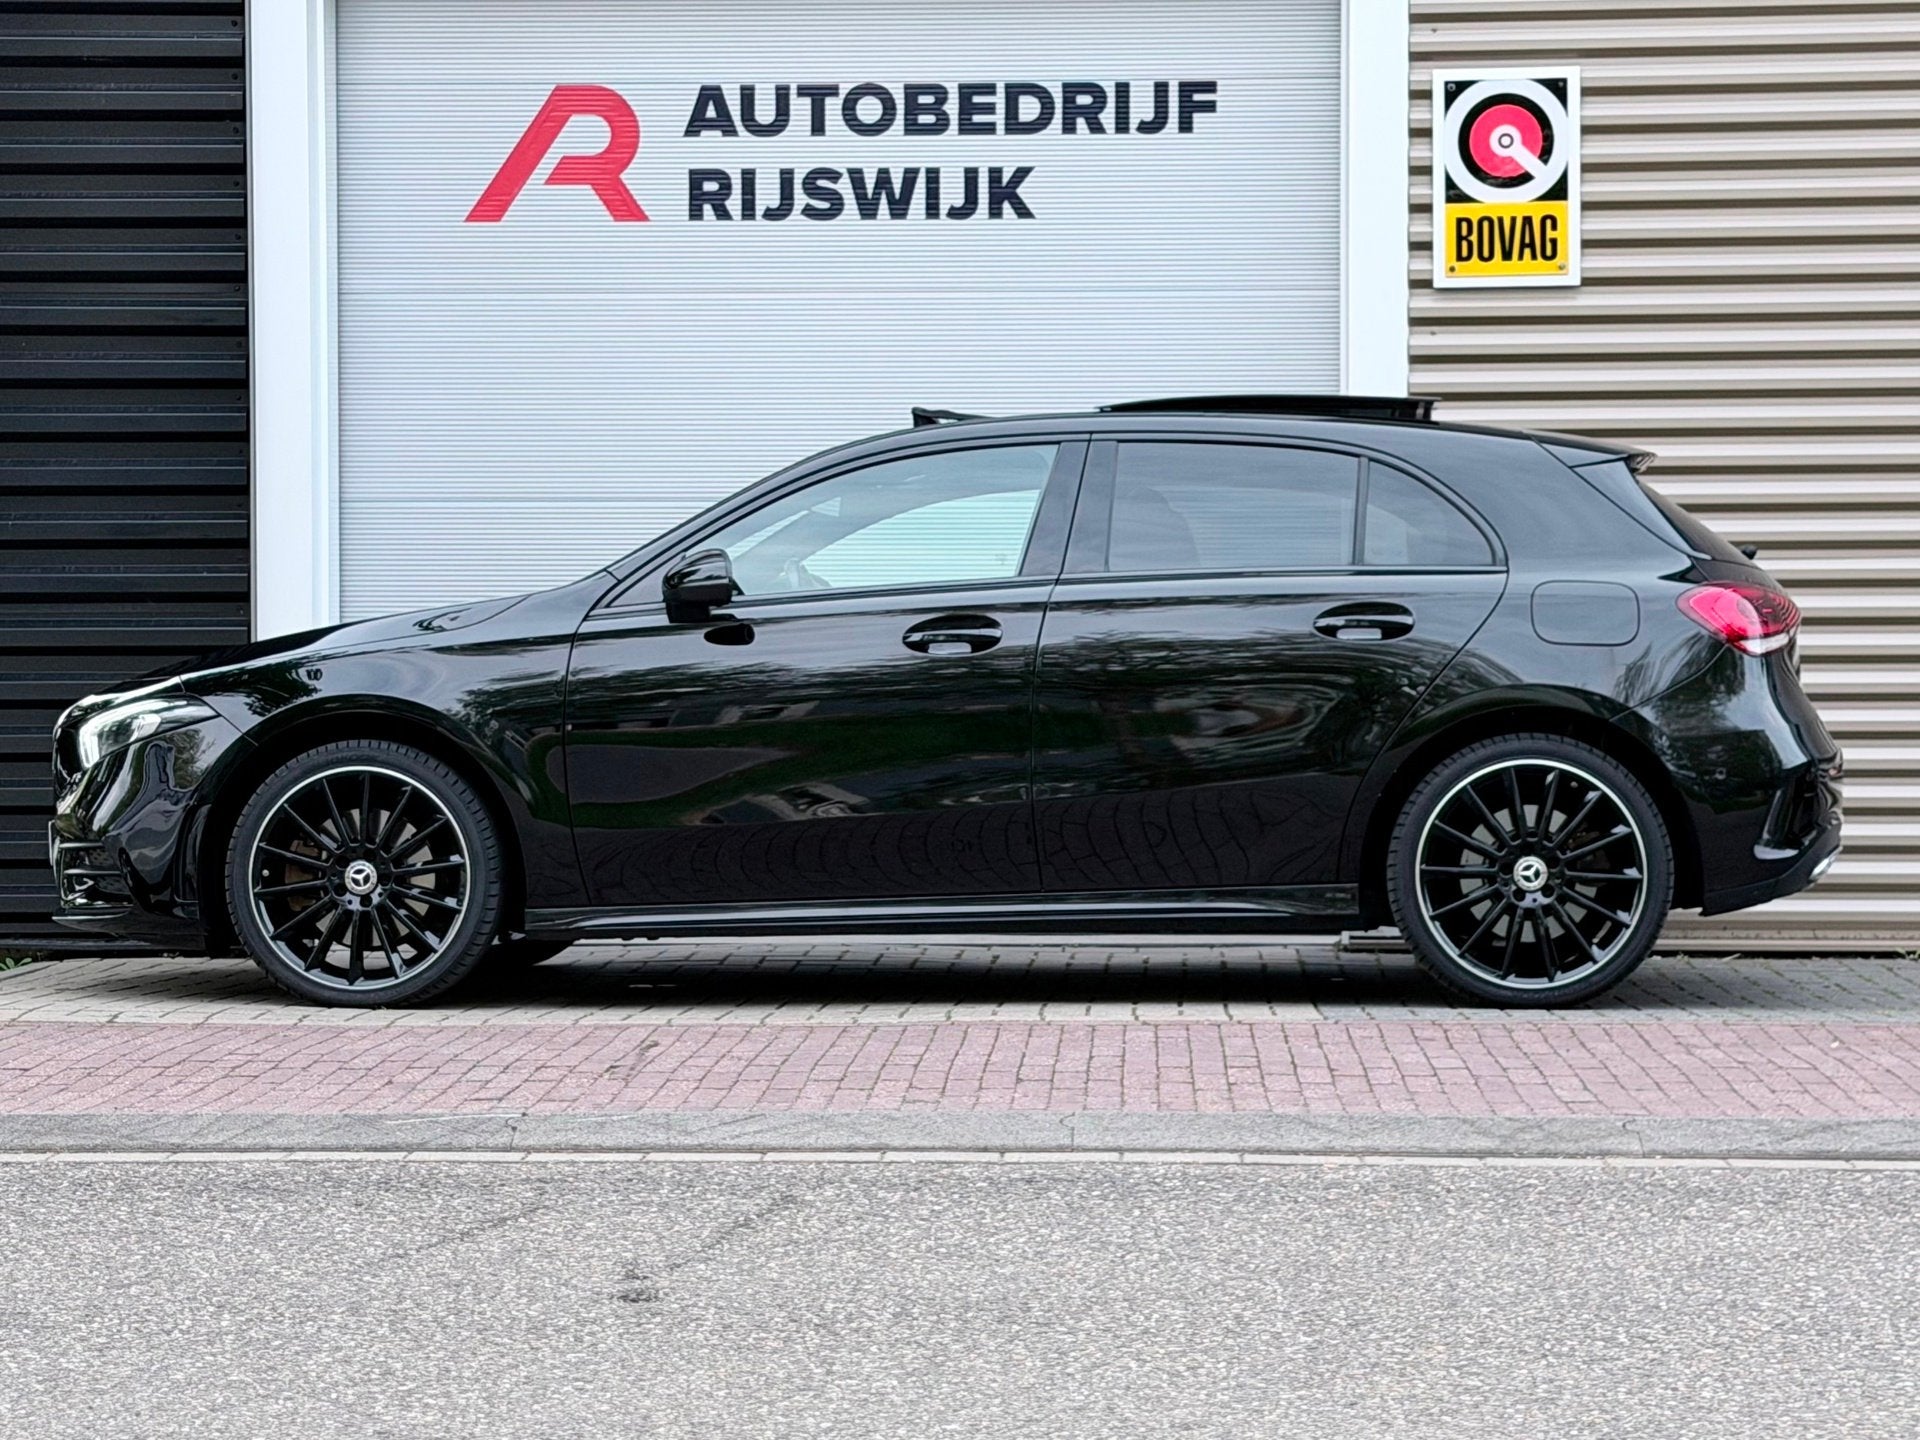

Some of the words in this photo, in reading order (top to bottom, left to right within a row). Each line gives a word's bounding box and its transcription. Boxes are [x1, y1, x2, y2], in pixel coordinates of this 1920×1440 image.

[684, 81, 1218, 137] AUTOBEDRIJF
[688, 166, 1036, 221] RIJSWIJK
[1455, 214, 1558, 263] BOVAG
